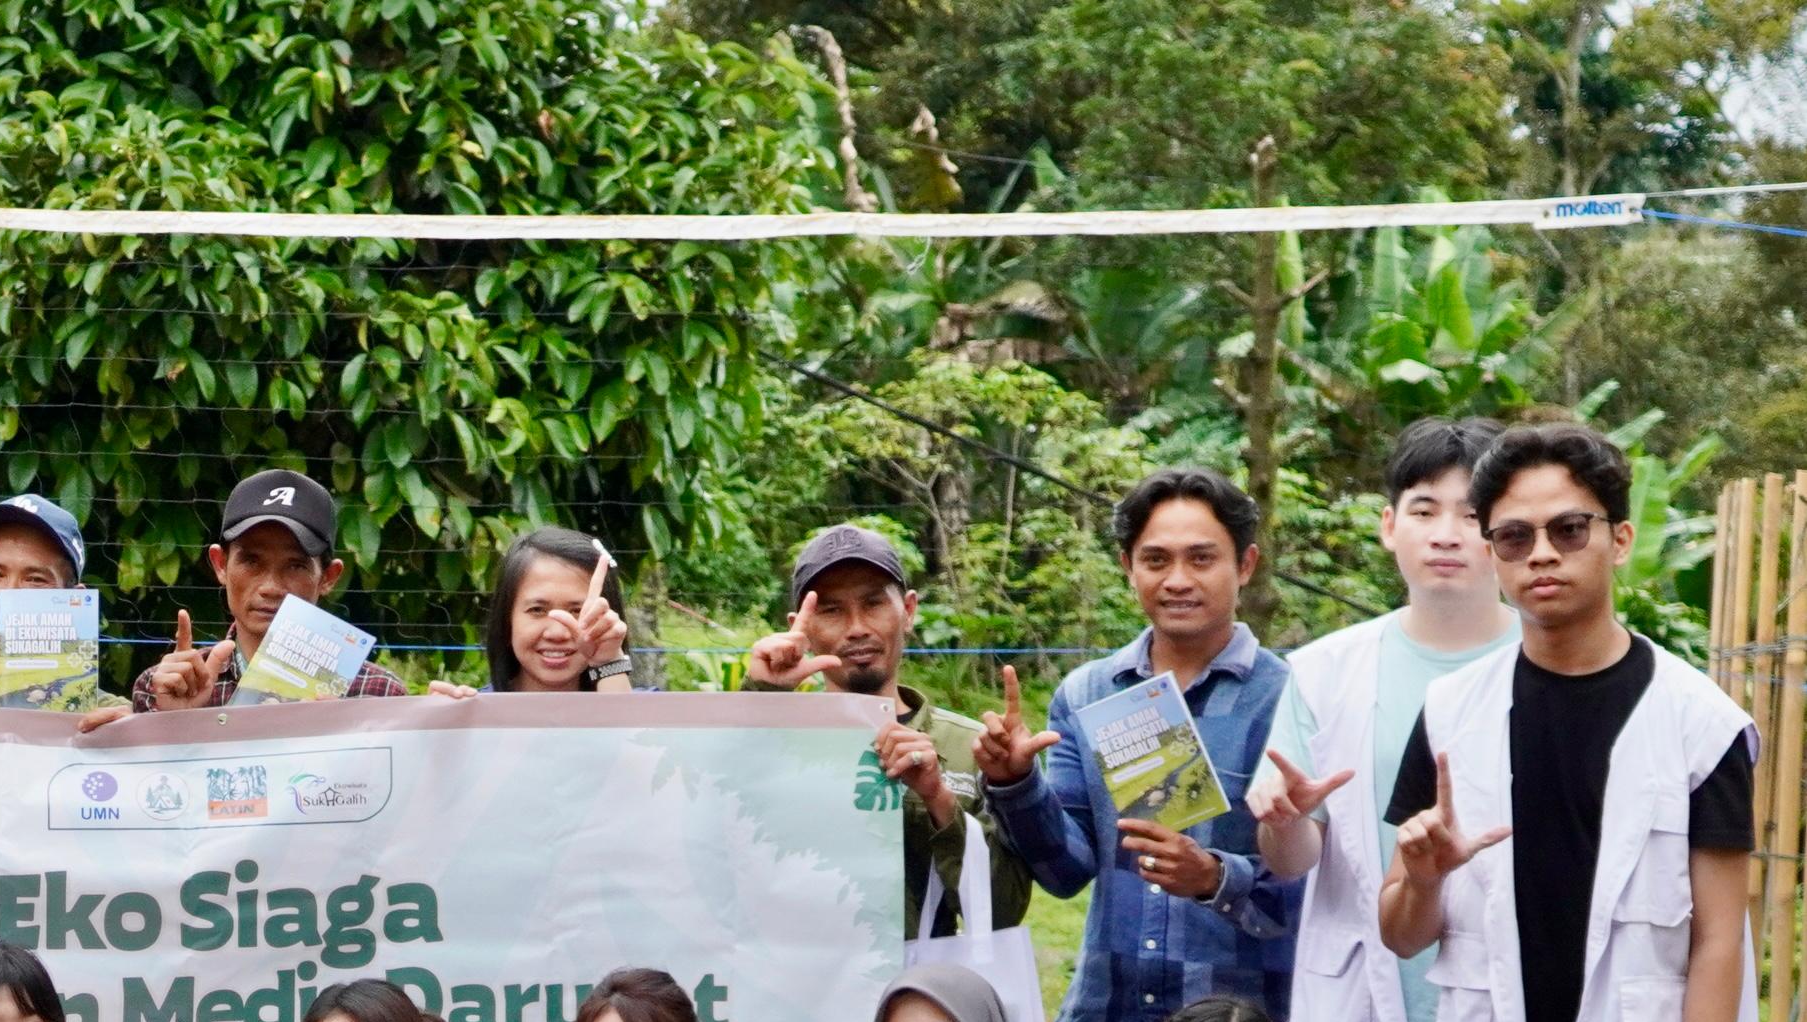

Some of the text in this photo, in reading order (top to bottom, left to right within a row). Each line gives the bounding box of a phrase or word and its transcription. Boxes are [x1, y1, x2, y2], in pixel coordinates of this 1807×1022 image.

[1556, 200, 1622, 216] molten
[81, 807, 120, 820] UMN
[209, 804, 255, 816] LATIN
[179, 859, 444, 970] Siaga
